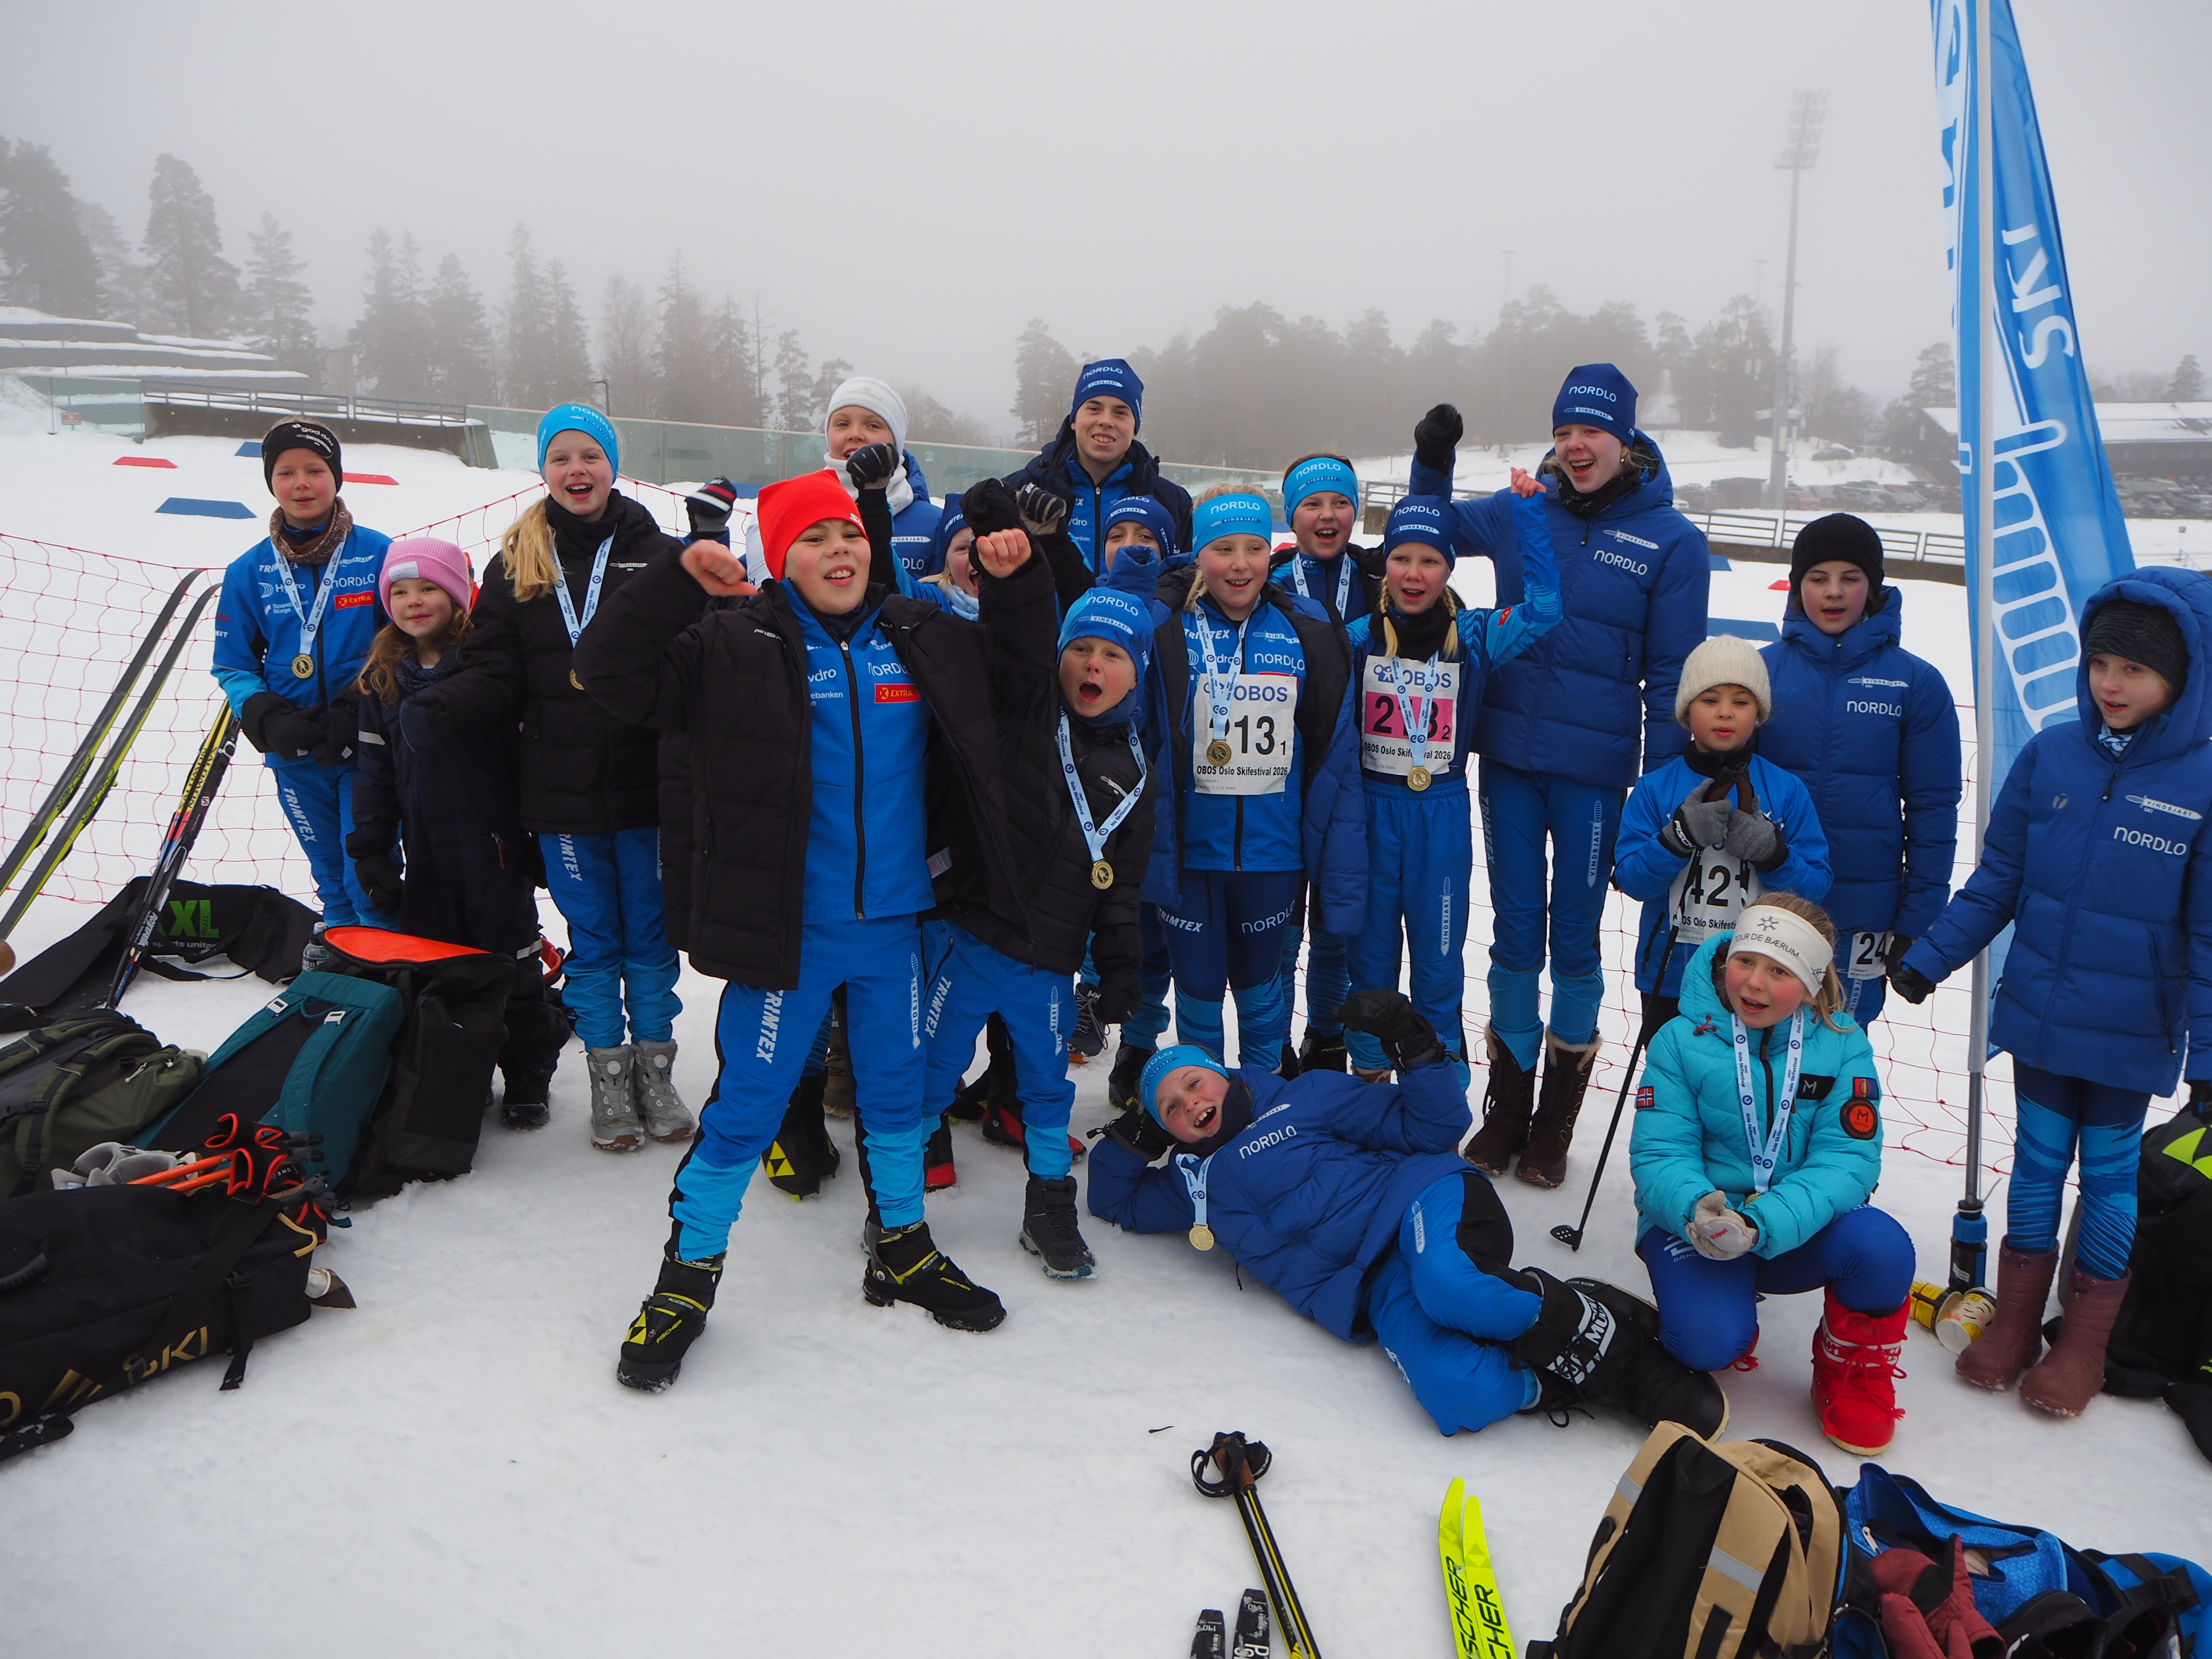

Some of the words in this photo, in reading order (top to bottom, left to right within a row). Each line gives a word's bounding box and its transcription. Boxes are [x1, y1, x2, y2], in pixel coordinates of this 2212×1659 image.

[2002, 223, 2074, 369] SKI
[1578, 408, 1609, 419] VINDBJART
[1619, 533, 1652, 547] VINDBJART
[902, 557, 925, 570] DLO
[273, 607, 291, 615] Norge
[1094, 617, 1129, 630] VINDBJART
[1183, 628, 1230, 639] TRITEX
[1267, 633, 1299, 644] VINDART
[1202, 654, 1234, 664] Hdro
[807, 669, 837, 683] ydro
[1228, 672, 1237, 693] Skifestival
[810, 691, 844, 700] ebanken
[1234, 685, 1288, 702] OBOS
[1404, 709, 1412, 730] Skifestival
[1441, 724, 1451, 740] 2
[1280, 740, 1286, 756] 1
[1364, 742, 1379, 753] OBOS
[1381, 745, 1395, 756] Oslo
[1397, 747, 1432, 759] Skifval
[1434, 750, 1451, 760] 2026
[1197, 766, 1217, 775] OBOS
[1219, 766, 1235, 775] Oslo
[1237, 767, 1272, 776] Skifestival
[1273, 767, 1288, 776] 2026
[1074, 792, 1085, 815] Skifestival
[1115, 801, 1131, 821] Skifestival
[2147, 800, 2192, 817] VINDBJART
[283, 788, 318, 842] TRIMTEX
[559, 833, 583, 881] RIMTEX
[1589, 826, 1600, 877] VINDBJART
[156, 900, 219, 938] XL
[1158, 906, 1203, 932] TRIMTEX
[1673, 914, 1692, 926] OS
[1751, 933, 1764, 942] DE
[1765, 938, 1800, 961] BÆRUM
[925, 976, 952, 1038] TRIMTEX
[756, 989, 783, 1064] TRIMTEX
[1747, 1123, 1756, 1148] Skifestival
[1775, 1118, 1786, 1142] Skifestival
[1673, 1252, 1700, 1263] DÆHL
[1445, 1555, 1479, 1659] SCHER
